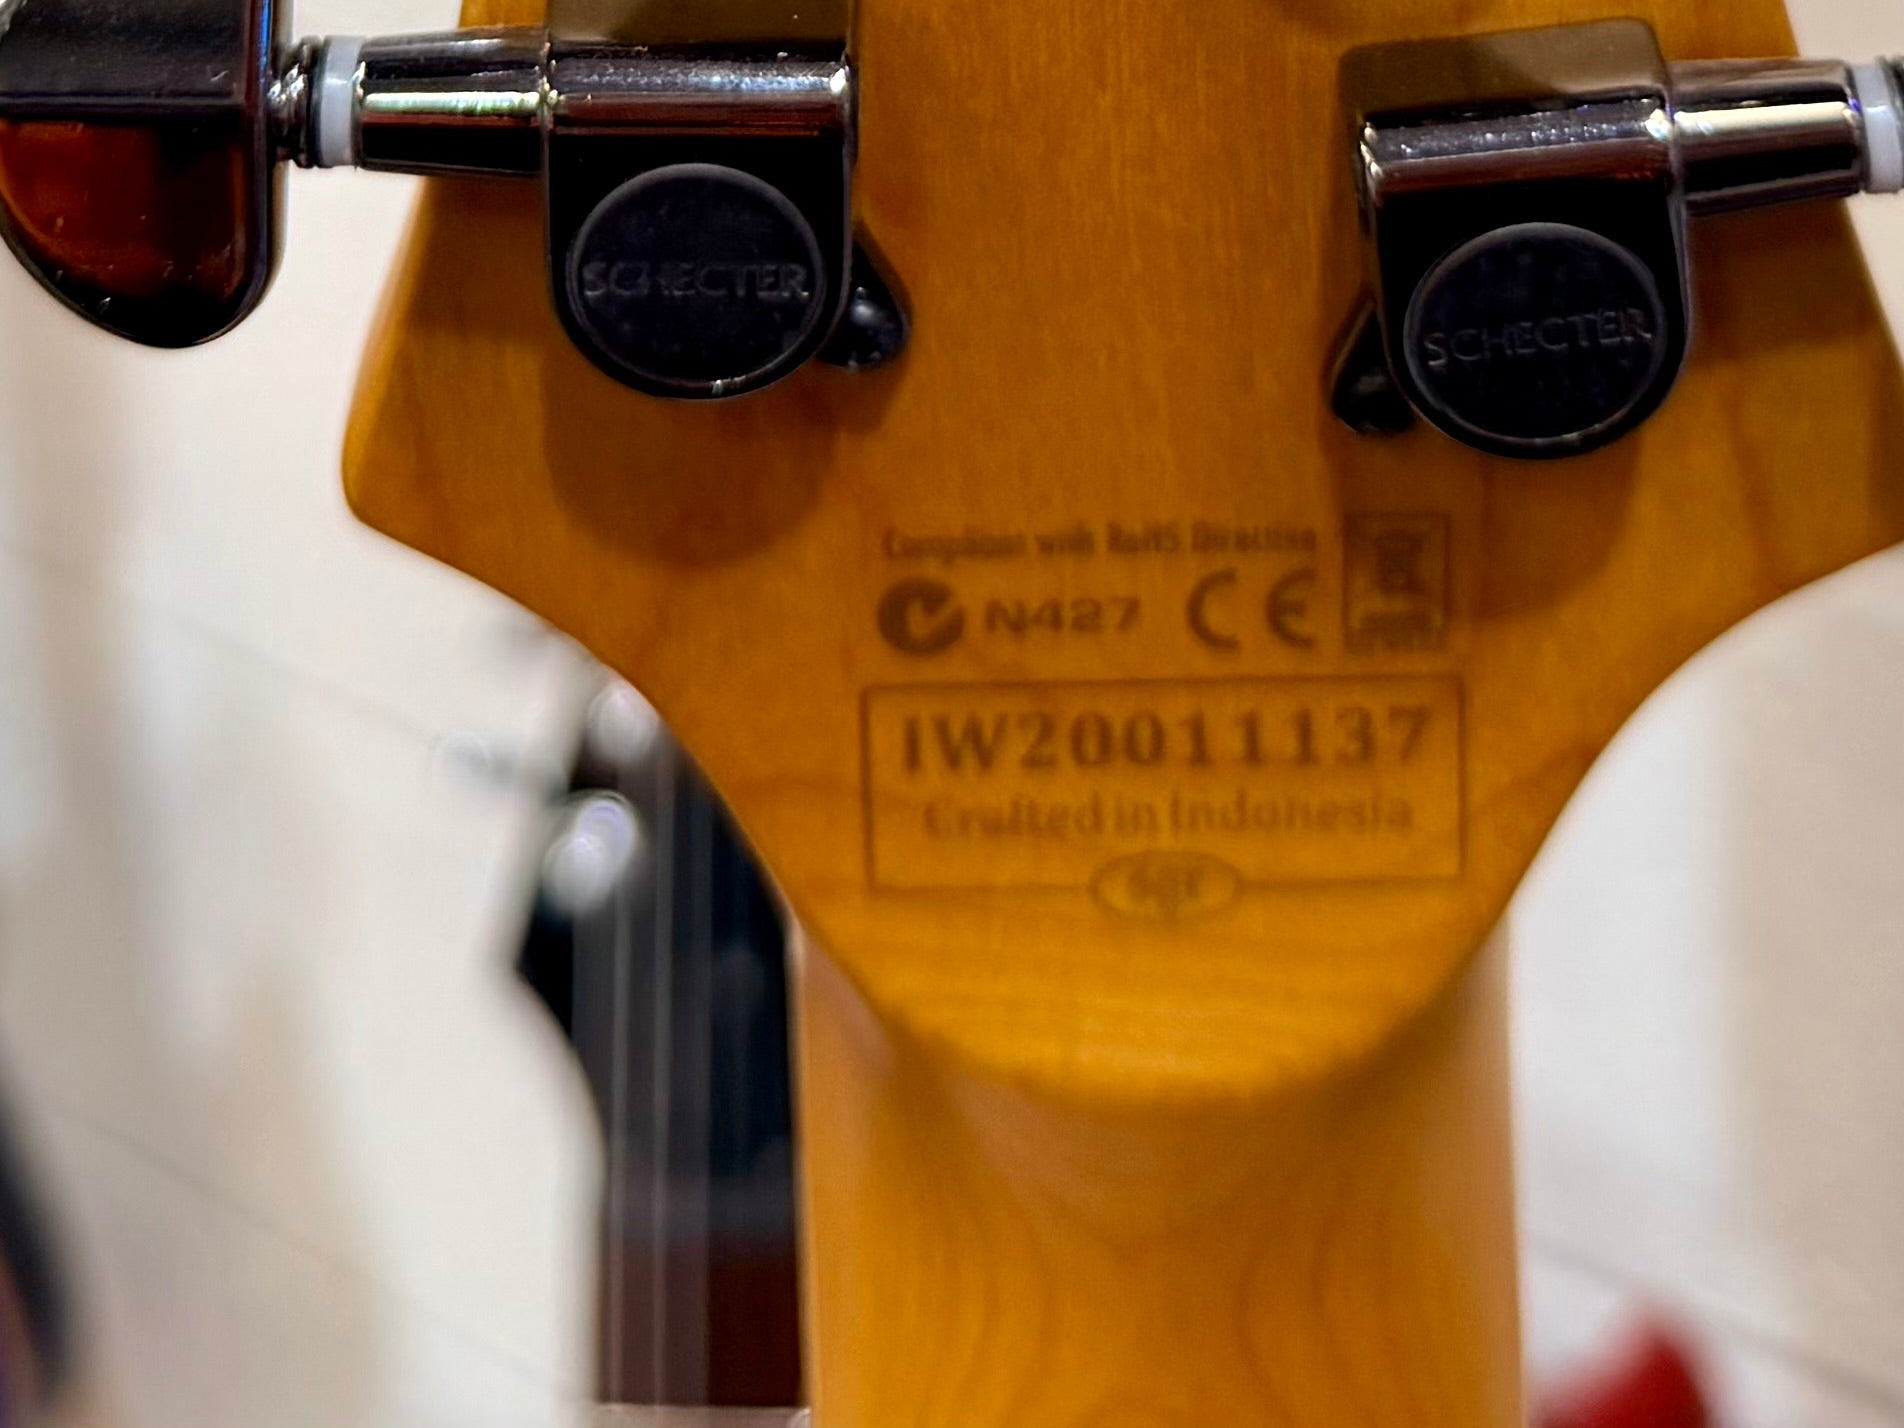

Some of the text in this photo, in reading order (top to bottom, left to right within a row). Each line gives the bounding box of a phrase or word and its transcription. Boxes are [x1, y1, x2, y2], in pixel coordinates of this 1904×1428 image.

[582, 260, 809, 298] SCHECTER
[1423, 307, 1652, 367] SCHECTER
[983, 596, 1142, 637] N427
[902, 703, 1434, 776] IW20011137
[922, 787, 1414, 841] Crafted in Indonesia
